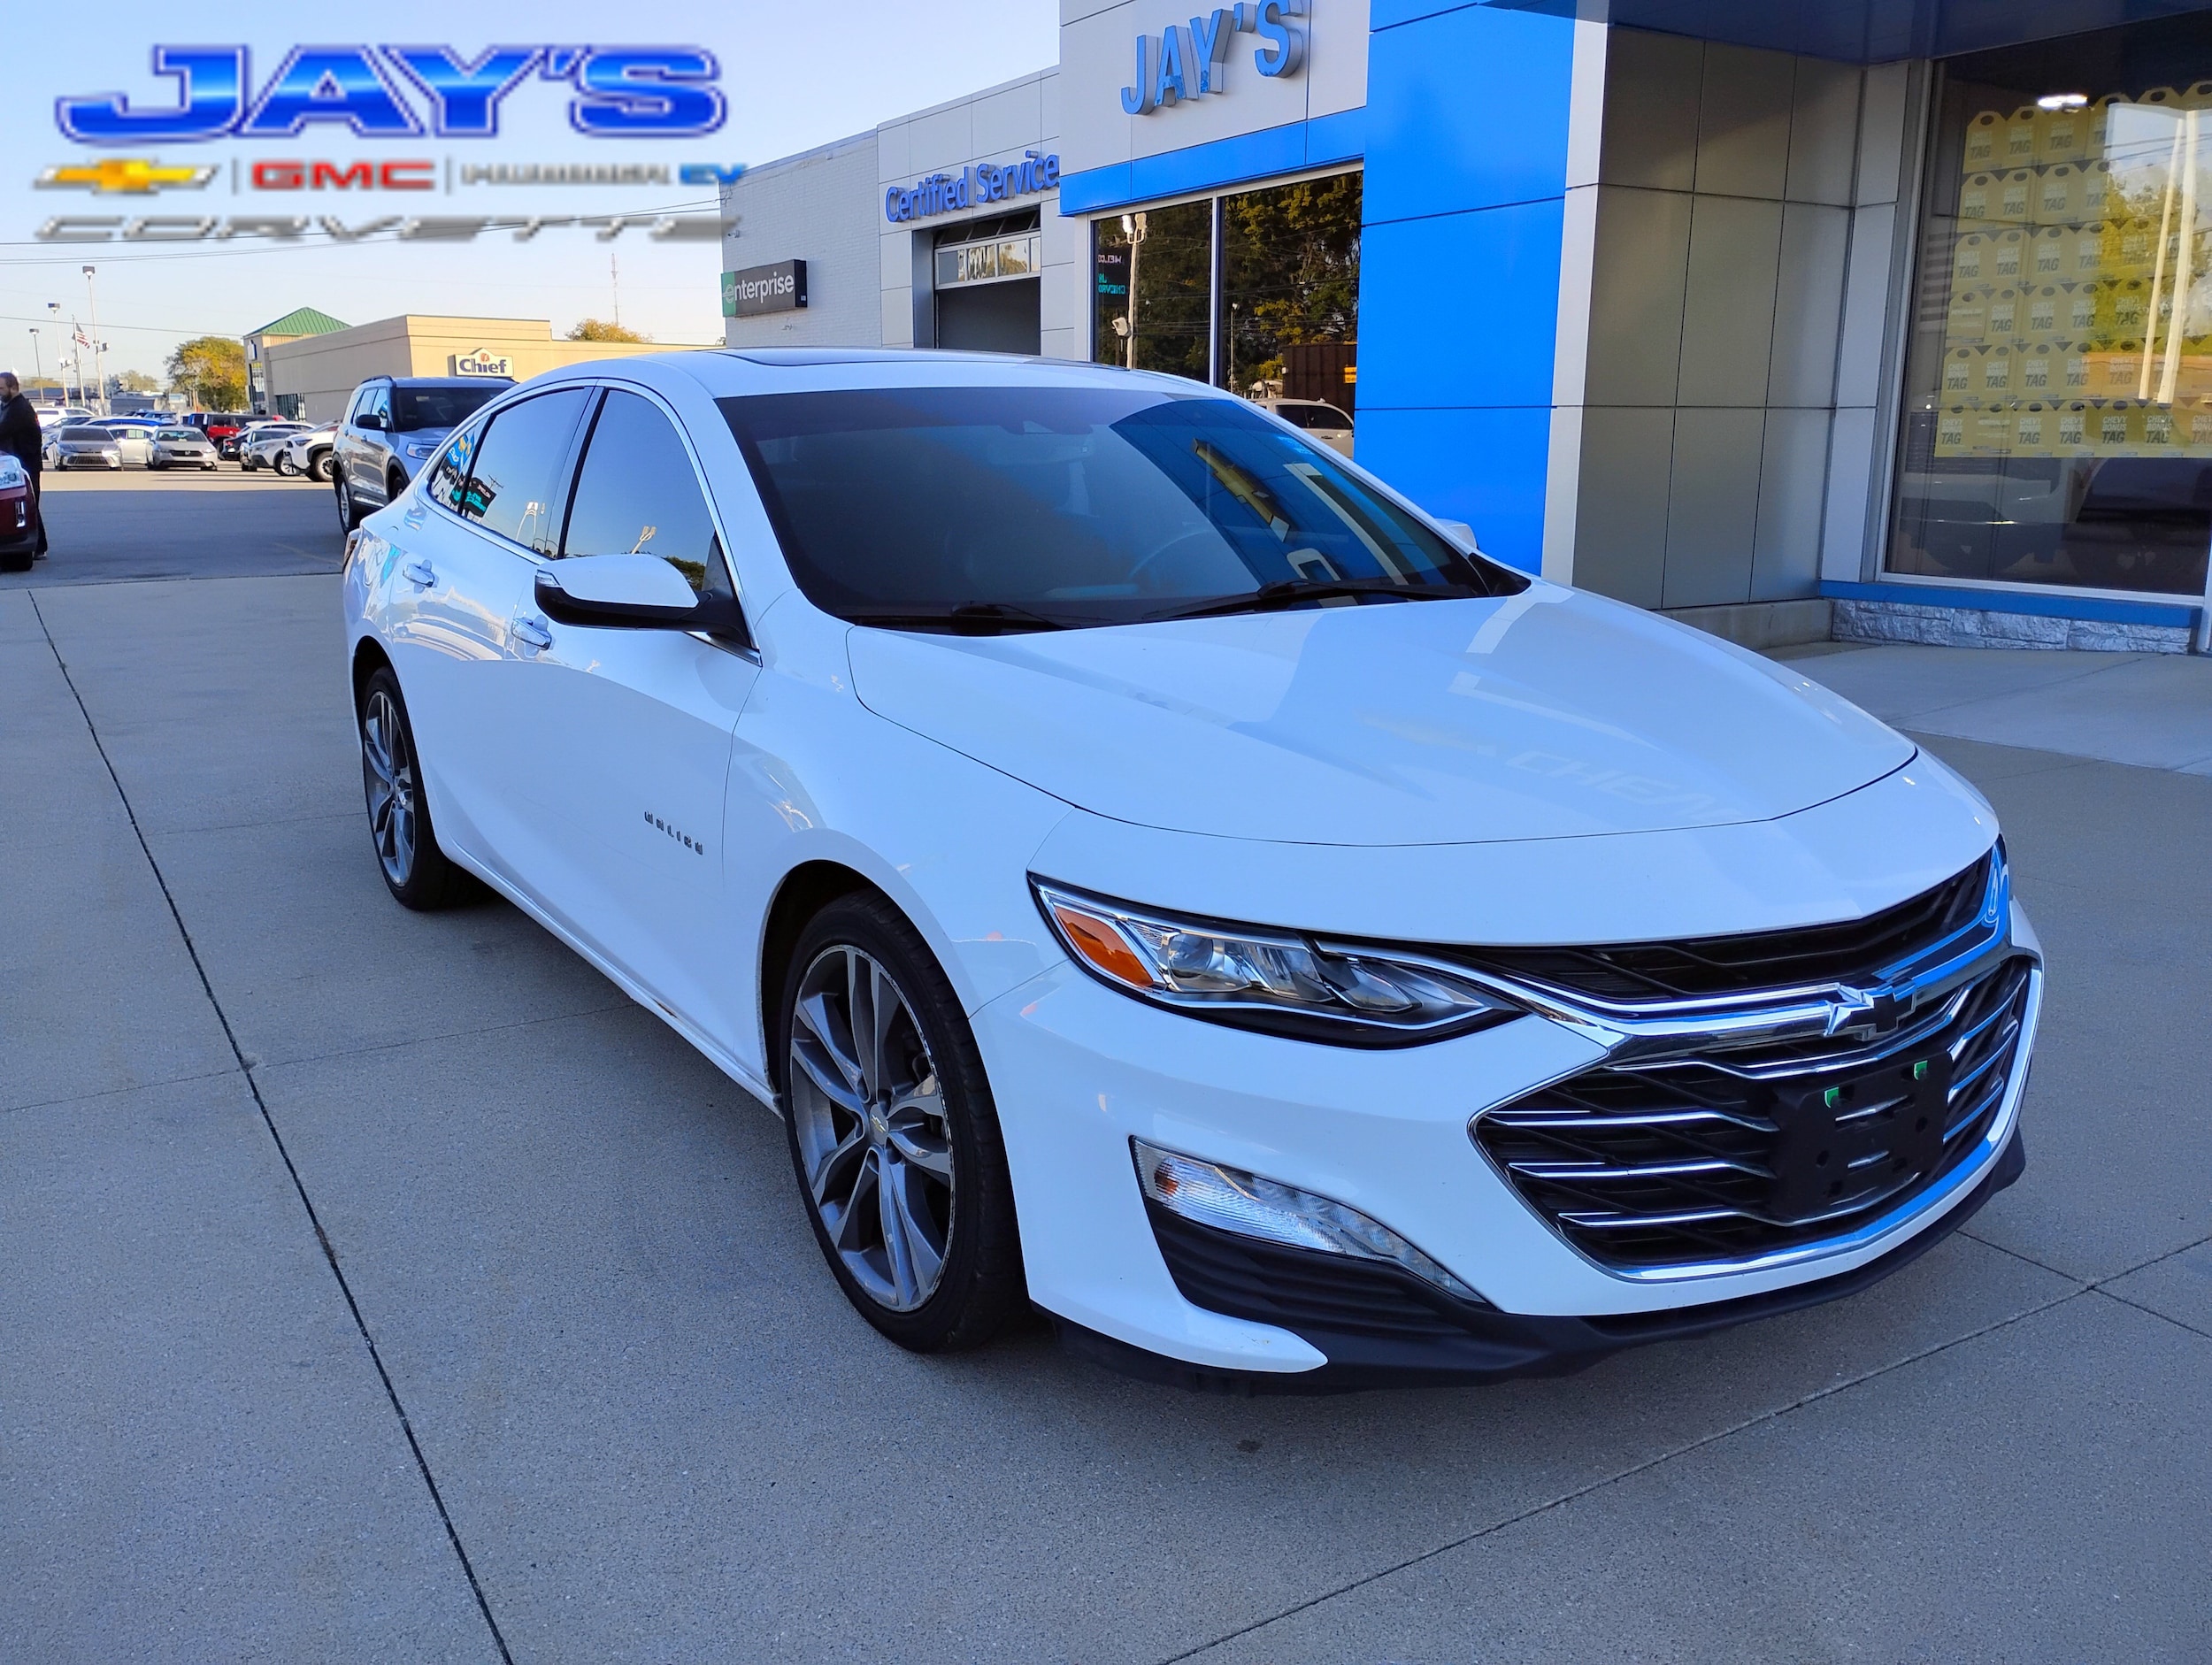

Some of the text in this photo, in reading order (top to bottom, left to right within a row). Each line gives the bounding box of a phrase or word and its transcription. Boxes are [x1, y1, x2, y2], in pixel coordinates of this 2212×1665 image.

[1121, 0, 1303, 115] JAY'S
[886, 150, 1060, 223] Certified Service
[2003, 202, 2025, 215] TAG
[2044, 197, 2066, 211] TAG
[1965, 205, 1985, 218] TAG
[1959, 265, 1979, 278] TAG
[1997, 262, 2017, 276] TAG
[2038, 258, 2060, 272] TAG
[722, 272, 795, 303] enterprise
[1992, 318, 2012, 333] TAG
[2032, 317, 2053, 330] TAG
[2072, 314, 2095, 328] TAG
[459, 358, 507, 373] Chief
[1947, 377, 1968, 389] TAG
[1986, 376, 2008, 388] TAG
[2025, 374, 2047, 387] TAG
[2067, 372, 2089, 386] TAG
[2109, 372, 2132, 385] TAG
[2102, 423, 2127, 432] BONUS
[1941, 433, 1962, 444] TAG
[2018, 432, 2040, 444] TAG
[2060, 432, 2082, 444] TAG
[2102, 431, 2125, 444] TAG
